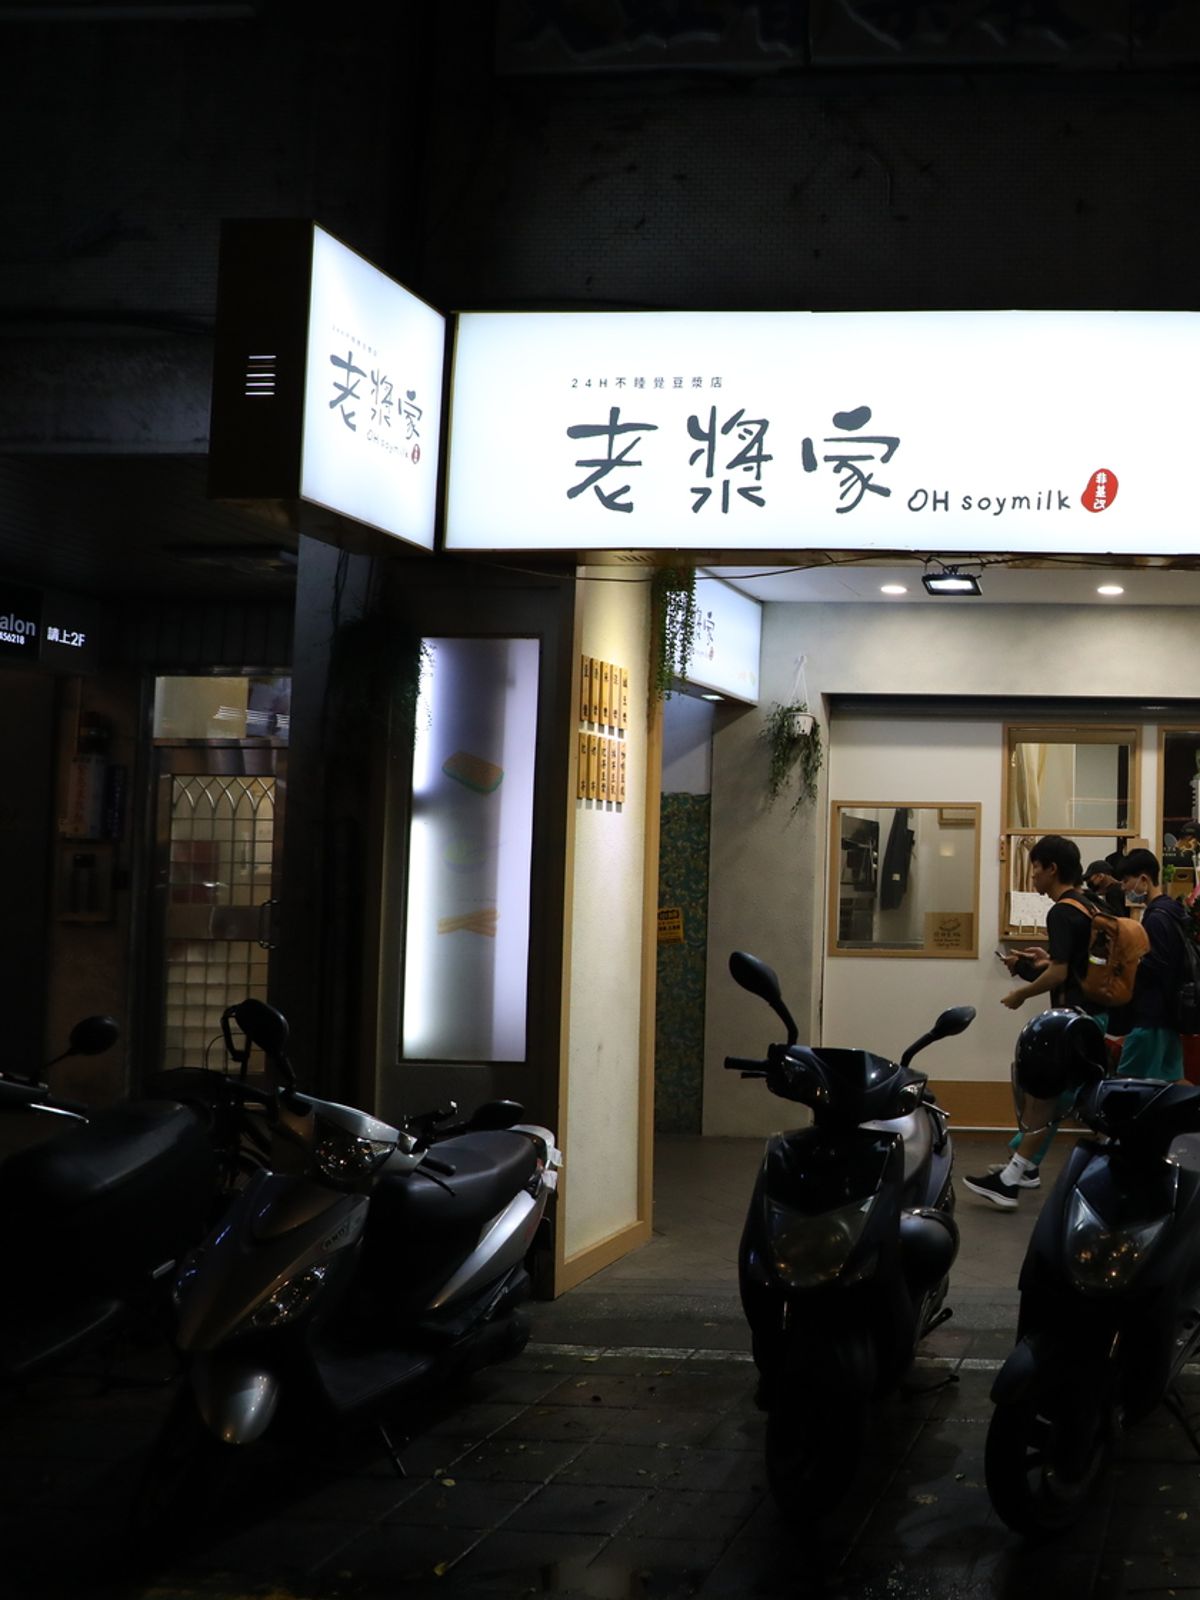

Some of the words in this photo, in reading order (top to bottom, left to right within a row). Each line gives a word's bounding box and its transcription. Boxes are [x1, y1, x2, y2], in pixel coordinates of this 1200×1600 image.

[566, 405, 900, 514] 老漿家
[907, 488, 949, 512] OH
[961, 489, 1071, 516] soymilk
[47, 626, 86, 647] 請上2F
